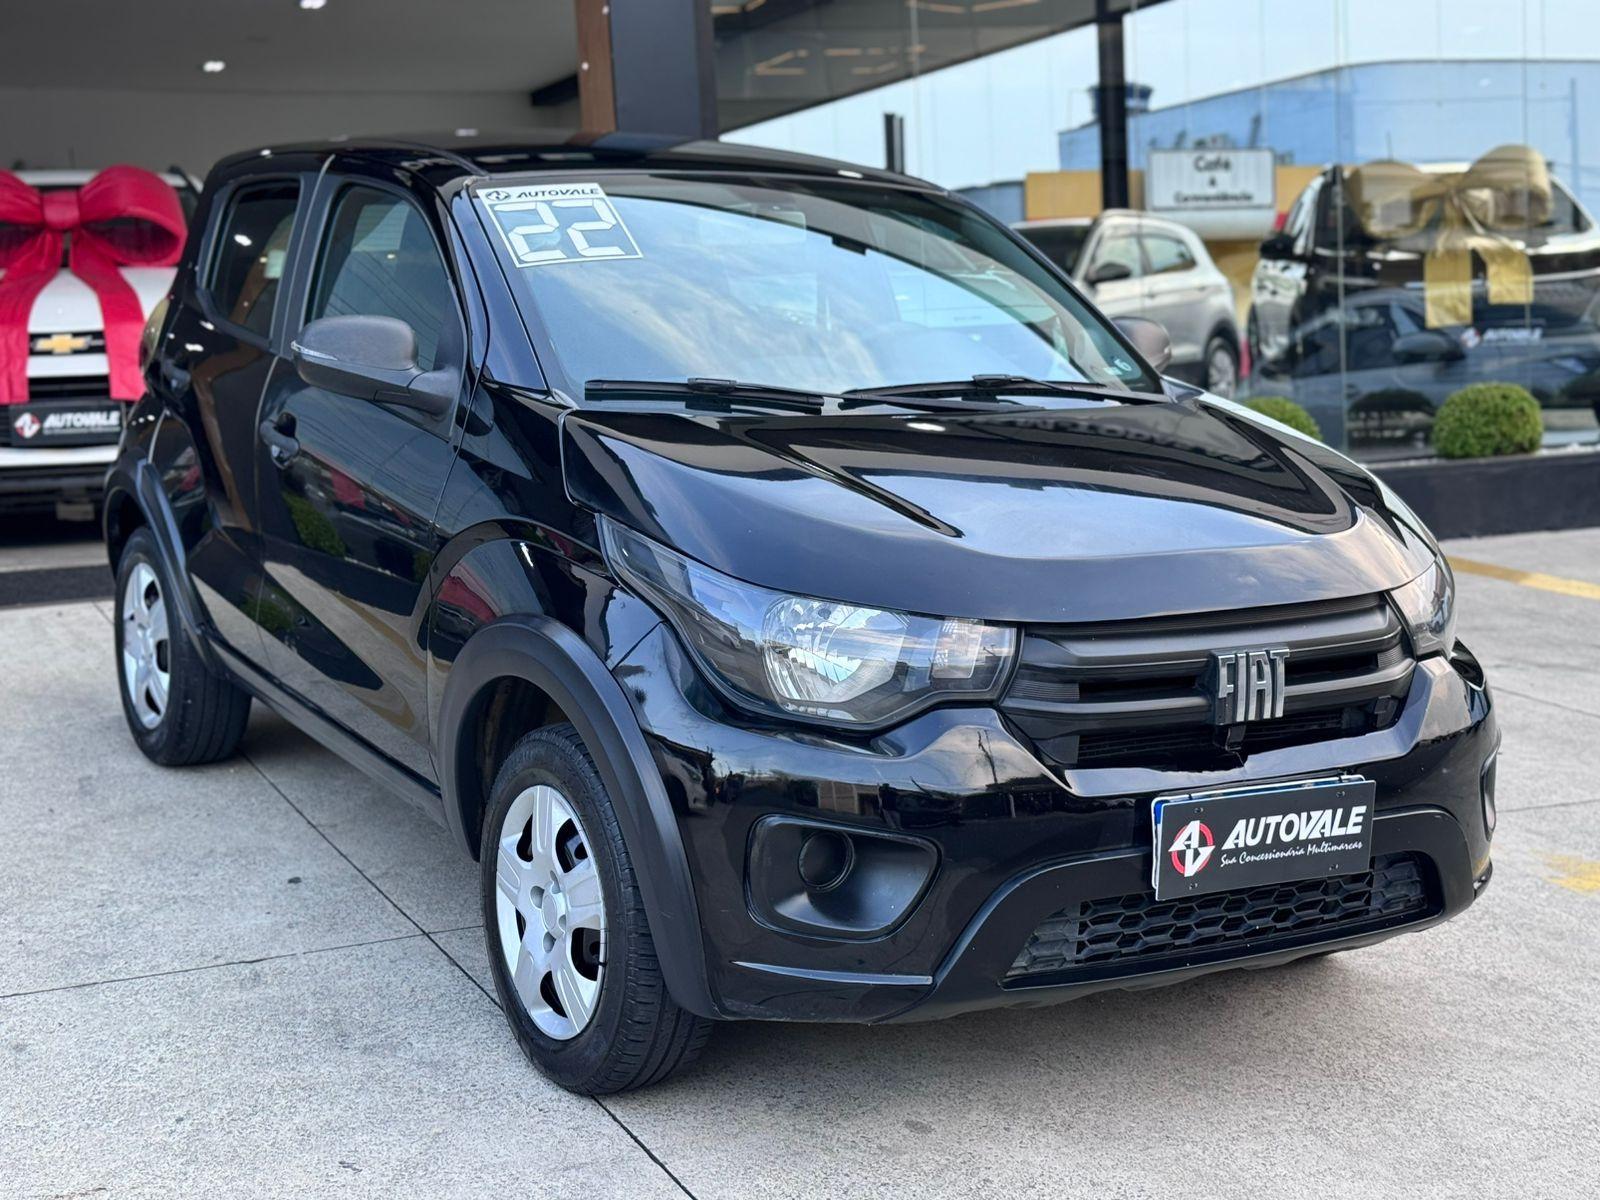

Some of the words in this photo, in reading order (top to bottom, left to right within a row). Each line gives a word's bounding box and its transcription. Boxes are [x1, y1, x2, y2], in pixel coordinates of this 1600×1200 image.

[516, 187, 600, 199] AUTOVALE
[493, 199, 626, 262] 22
[43, 410, 120, 429] AUTOVALE
[1218, 648, 1290, 722] FIAT
[1221, 805, 1367, 850] AUTOVALE
[1220, 853, 1237, 867] Sua
[1307, 840, 1363, 856] Multimarcas
